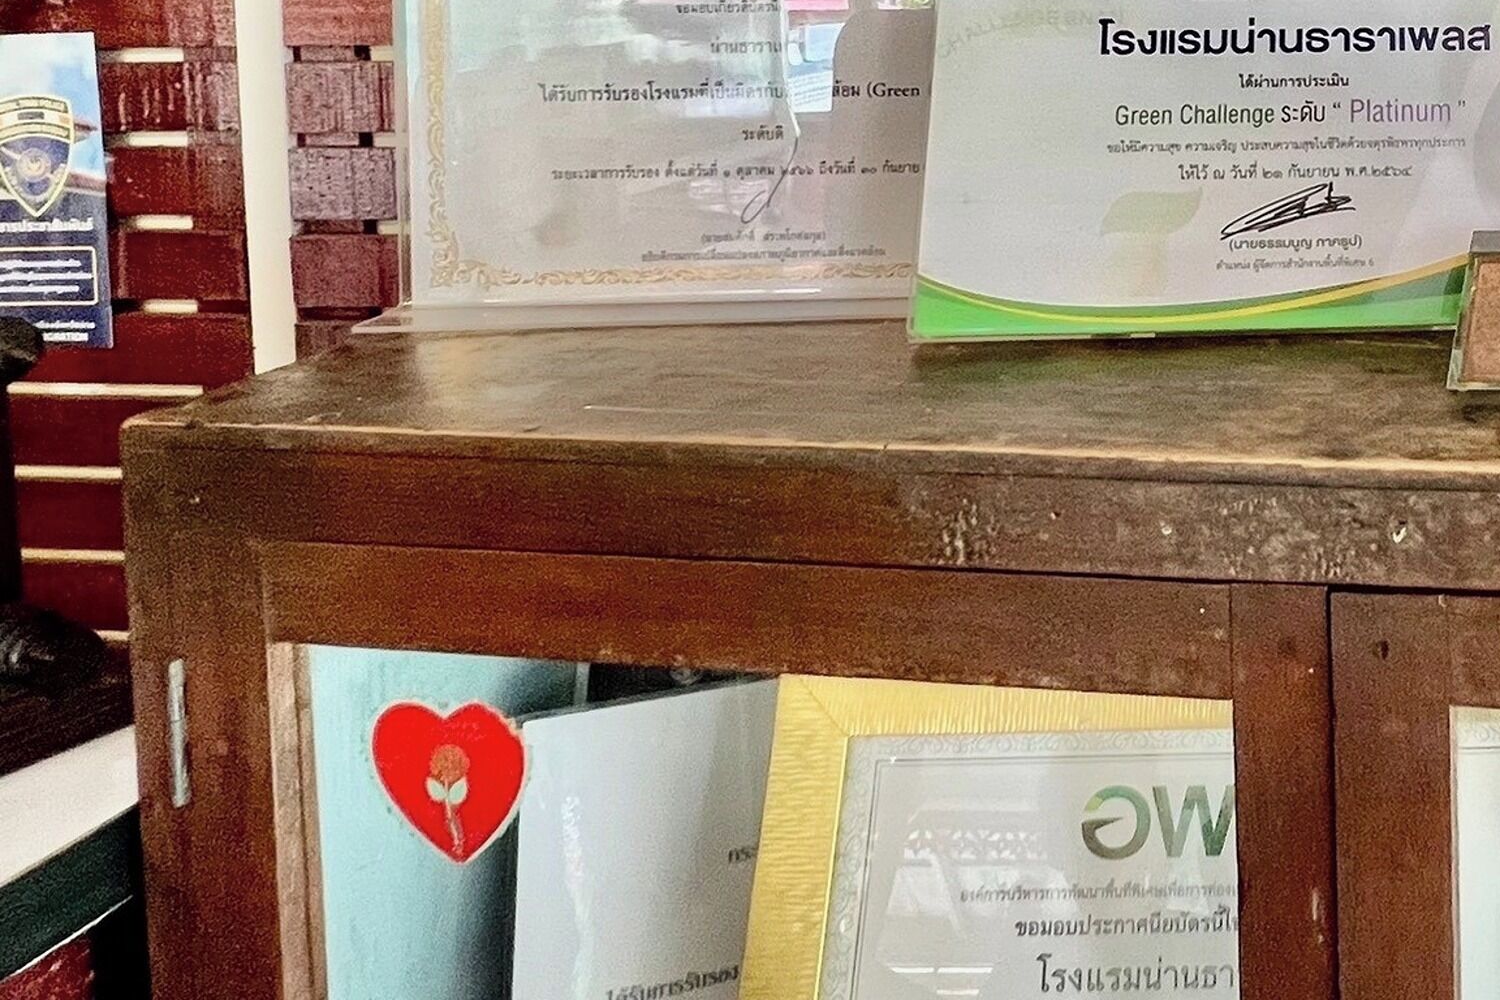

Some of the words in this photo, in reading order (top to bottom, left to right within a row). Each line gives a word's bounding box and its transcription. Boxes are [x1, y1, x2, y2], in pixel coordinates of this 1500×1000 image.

[1099, 18, 1491, 56] โรงแรมน่านธาราเพลส
[866, 82, 921, 99] (Green
[1238, 72, 1350, 89] ได้ผ่านการประเมิน
[1115, 105, 1173, 126] Green
[1180, 103, 1275, 128] Challenge
[1280, 100, 1326, 123] ระดับ
[1350, 98, 1452, 123] Platinum
[1178, 164, 1208, 180] ให้ไว้
[1230, 161, 1258, 179] วันที่
[1288, 163, 1341, 179] กันยายน
[1081, 785, 1237, 860] อพ
[1036, 953, 1234, 993] โรงแรมน่านธา
